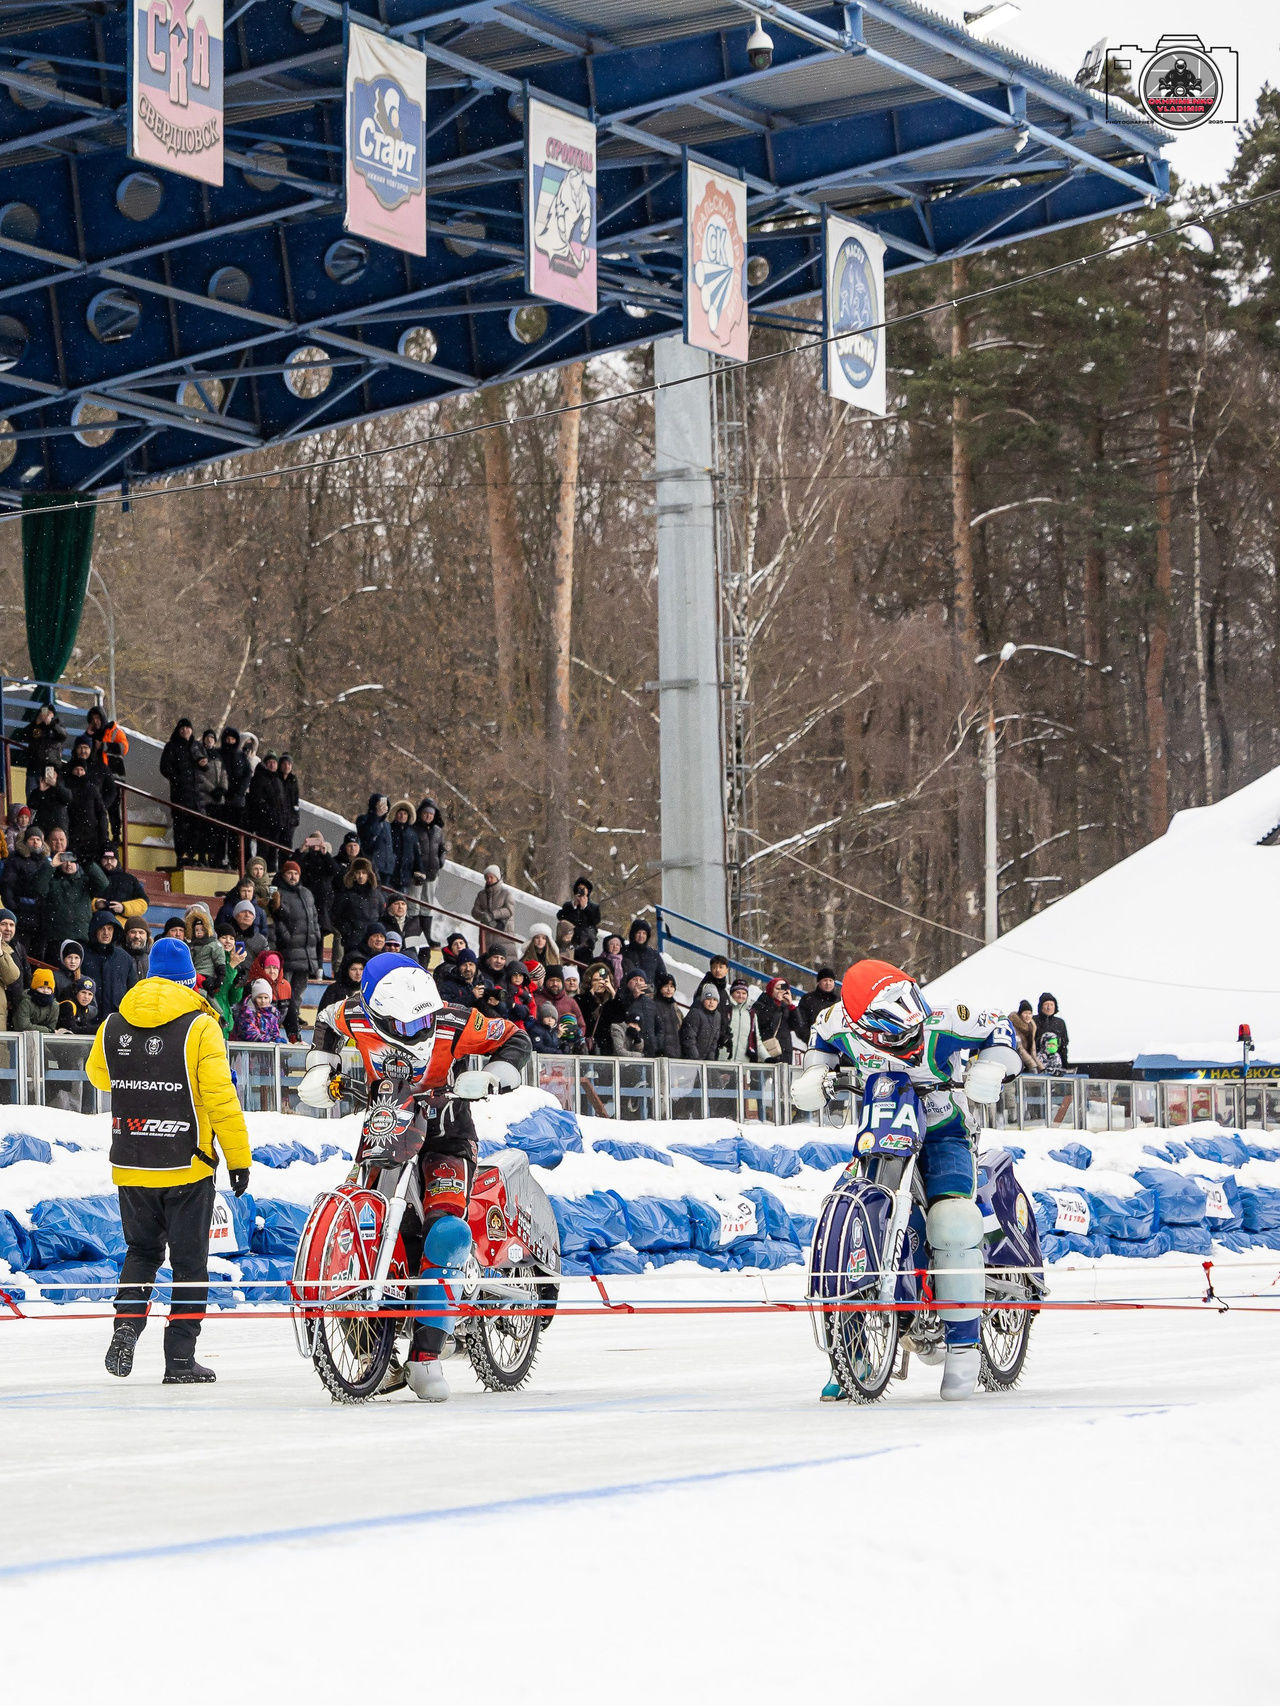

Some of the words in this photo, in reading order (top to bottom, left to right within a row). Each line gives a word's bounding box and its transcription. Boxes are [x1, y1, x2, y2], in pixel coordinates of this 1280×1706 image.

[147, 1, 210, 107] СКА
[138, 94, 220, 157] СВЕРДЛОВСК
[360, 117, 416, 177] Старт
[414, 1002, 433, 1012] SHOEI
[1210, 1069, 1240, 1079] НАС
[111, 1080, 183, 1092] РГАНИЗАТОР
[143, 1119, 190, 1133] RGP
